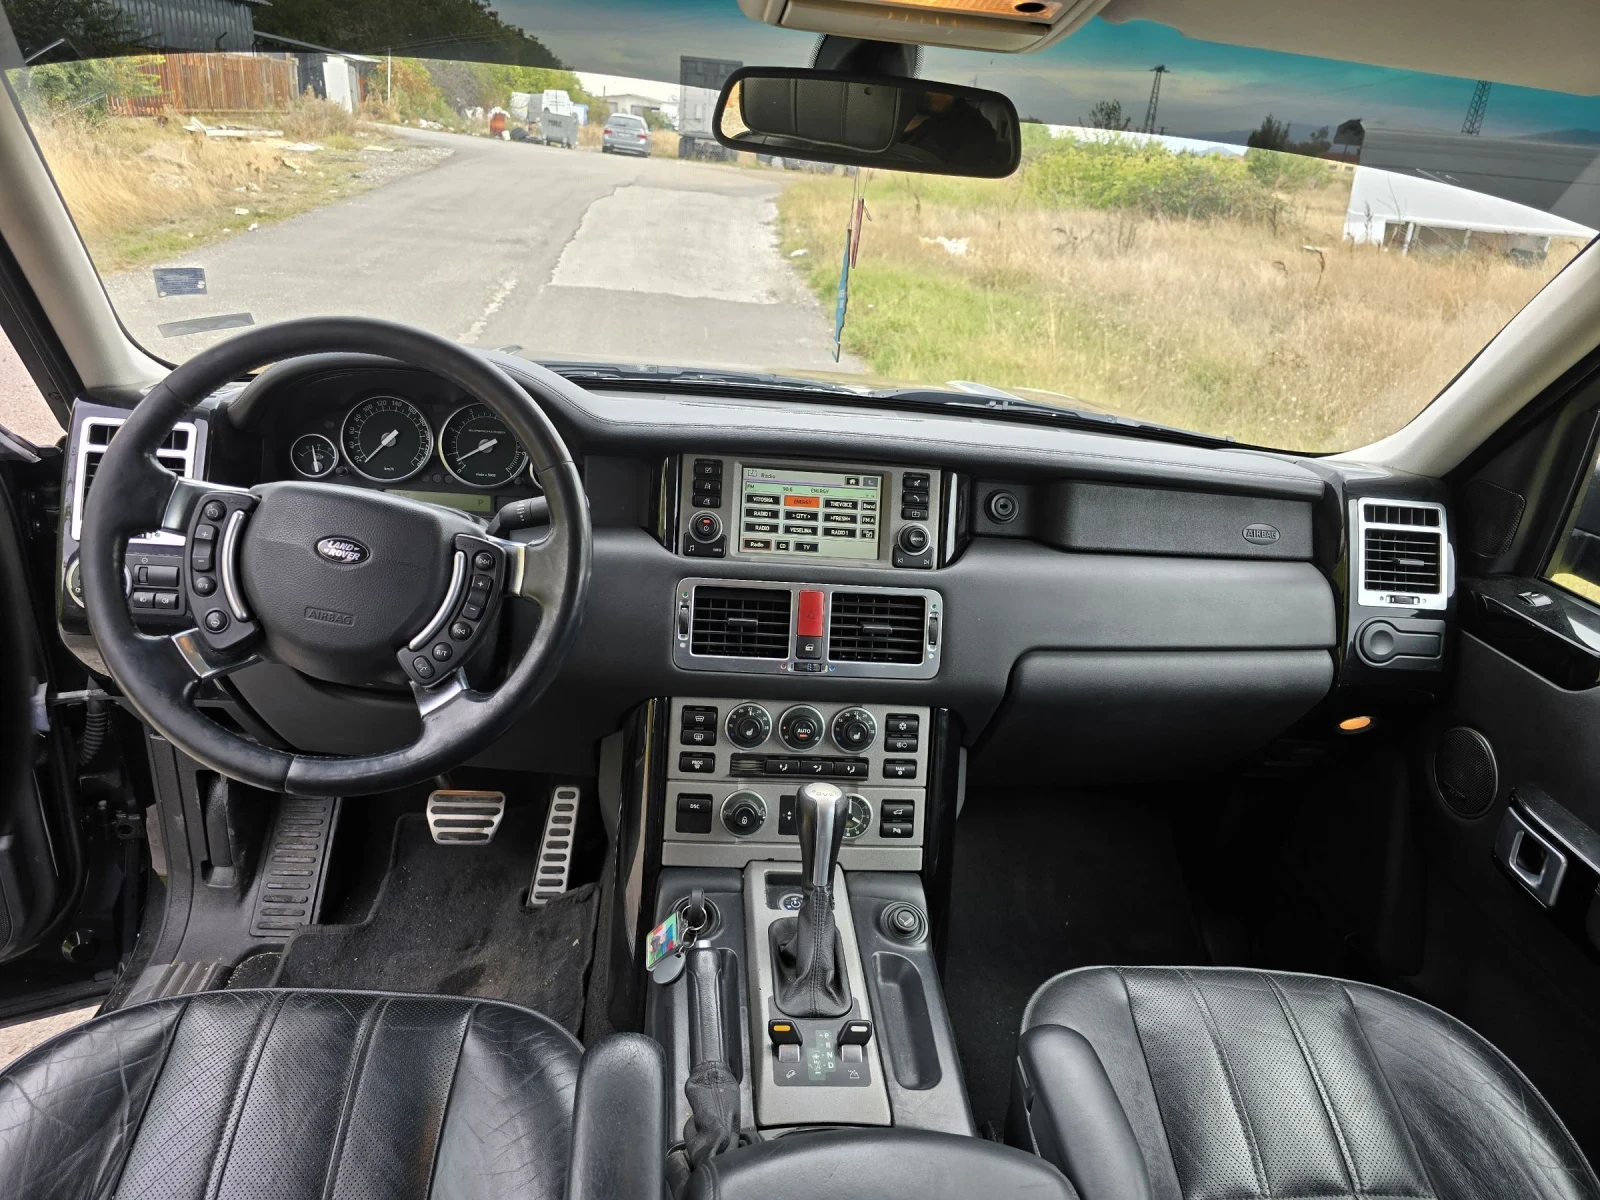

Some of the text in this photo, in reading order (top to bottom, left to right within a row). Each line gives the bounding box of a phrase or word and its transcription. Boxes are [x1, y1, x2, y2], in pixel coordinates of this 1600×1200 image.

[363, 404, 373, 412] 100
[407, 407, 417, 415] 160
[354, 414, 361, 422] 80
[1246, 529, 1278, 539] AIRBAG
[328, 540, 354, 551] LAND
[328, 548, 361, 560] ROVER
[308, 610, 352, 624] AIRBAG
